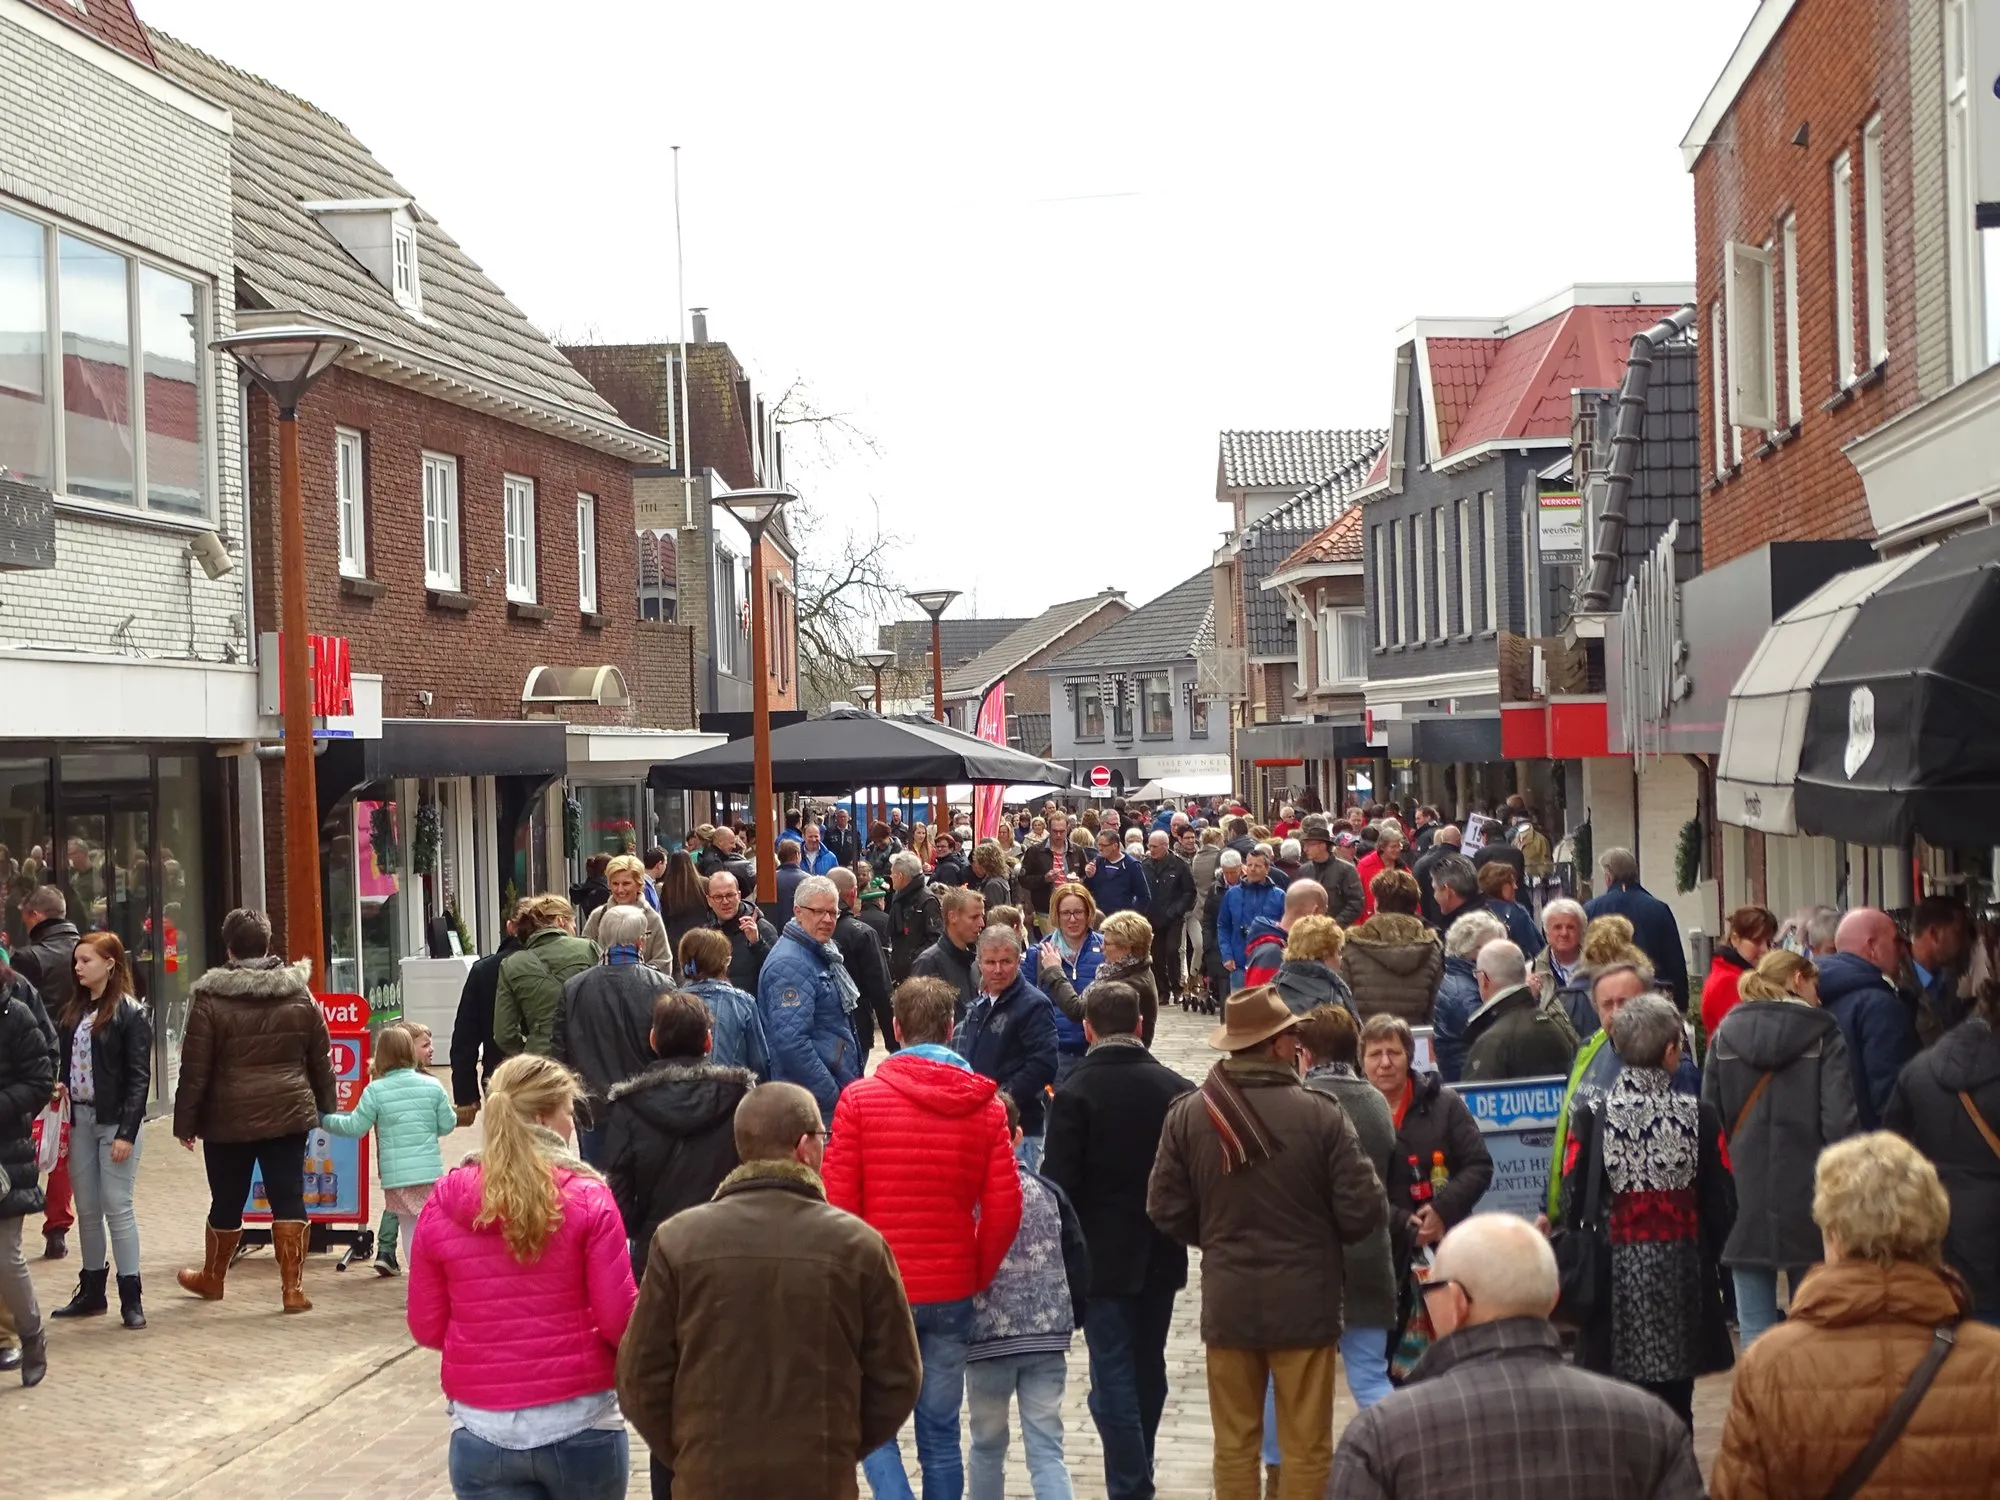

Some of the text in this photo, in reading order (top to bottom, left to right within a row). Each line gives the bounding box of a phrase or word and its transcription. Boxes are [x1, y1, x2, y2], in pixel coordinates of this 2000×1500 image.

[1541, 498, 1581, 506] VERKOCHT
[1476, 1093, 1497, 1118] DE
[1497, 1160, 1526, 1173] WIJ
